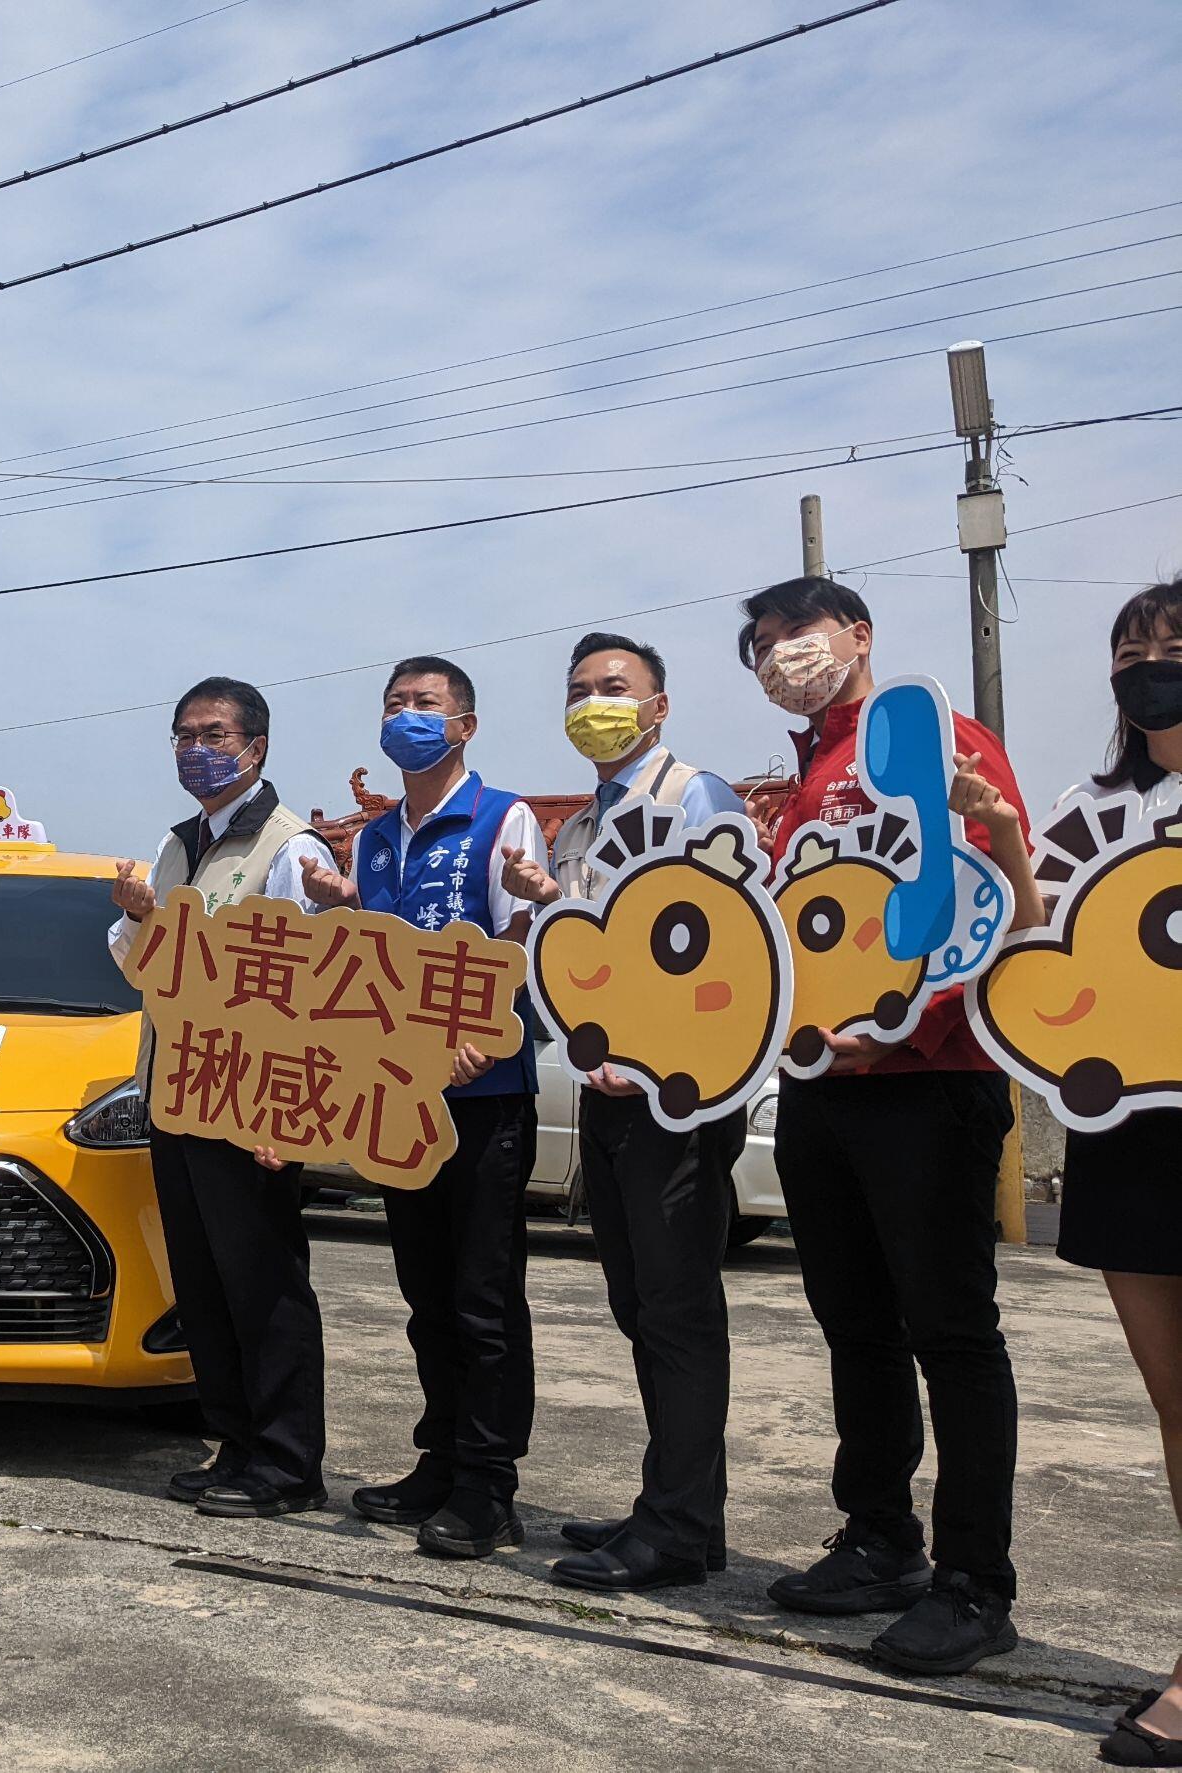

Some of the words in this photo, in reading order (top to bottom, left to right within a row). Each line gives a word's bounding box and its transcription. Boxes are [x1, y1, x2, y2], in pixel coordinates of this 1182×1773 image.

[824, 807, 855, 822] 台南市
[416, 846, 450, 931] 方一峰
[137, 902, 509, 1050] 小黃公車
[165, 1020, 438, 1170] 揪感心
